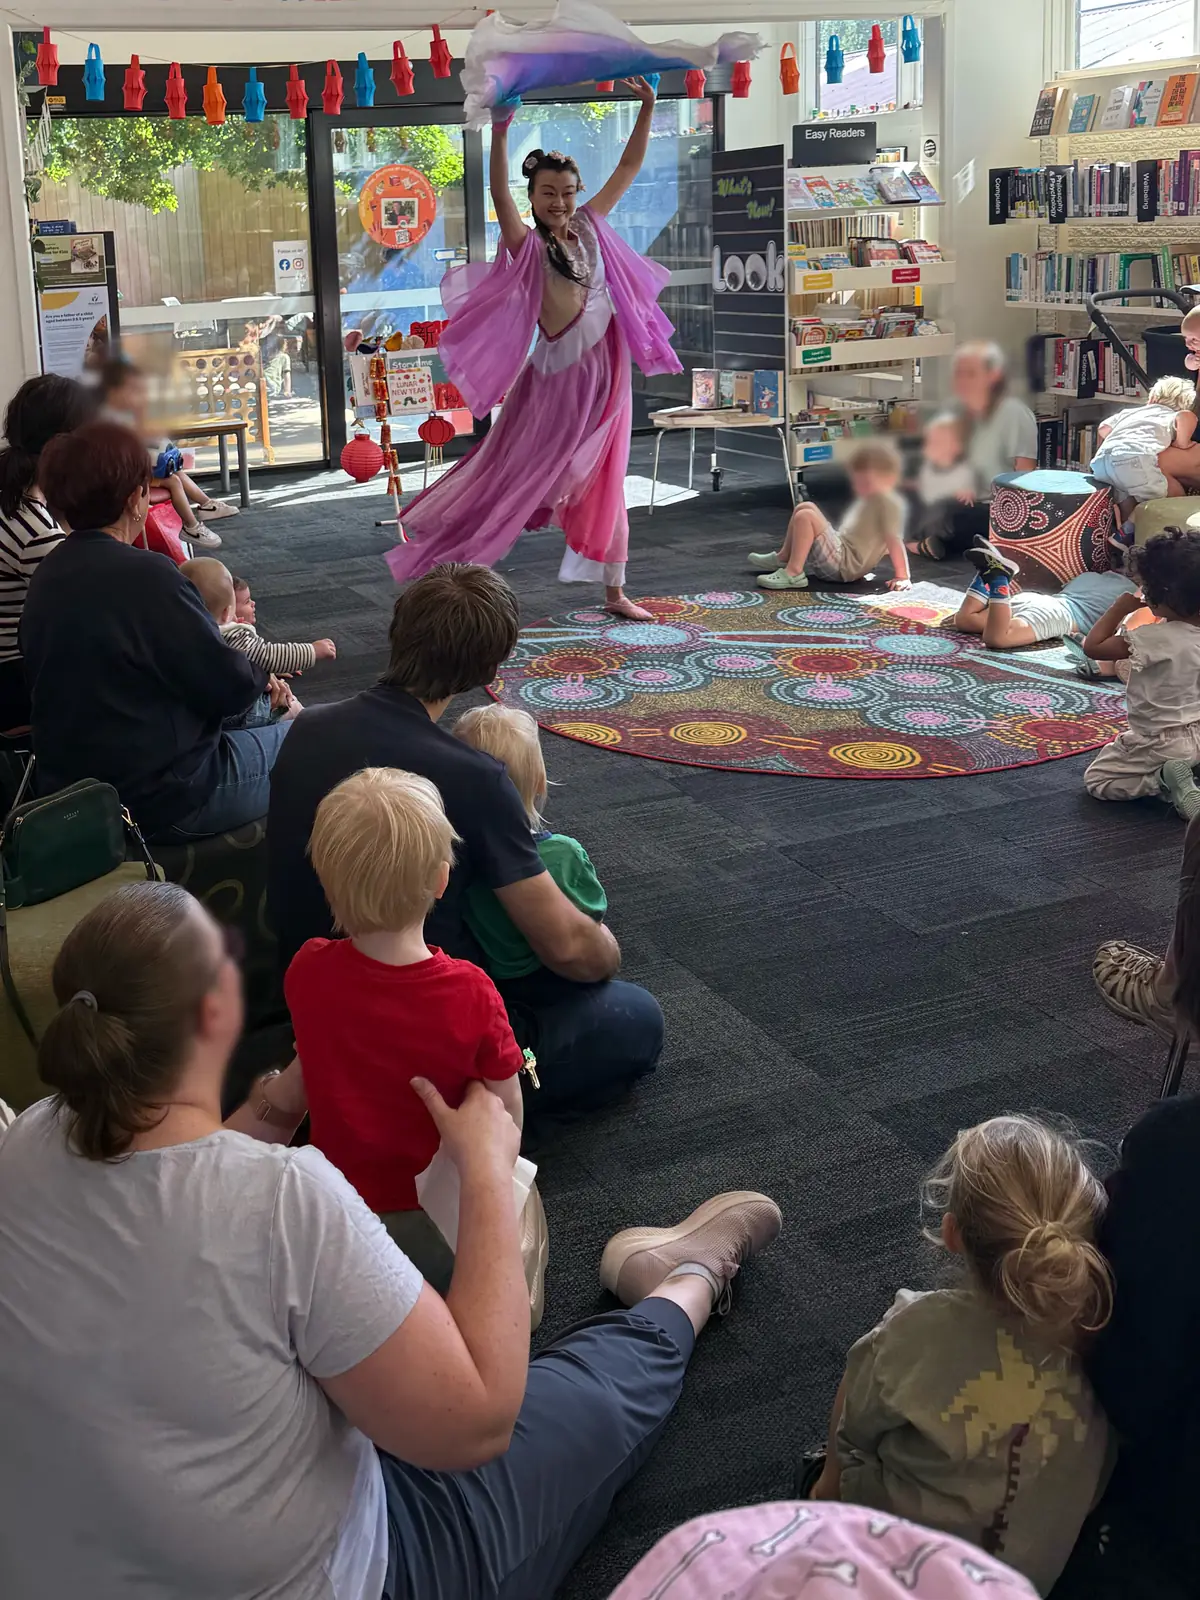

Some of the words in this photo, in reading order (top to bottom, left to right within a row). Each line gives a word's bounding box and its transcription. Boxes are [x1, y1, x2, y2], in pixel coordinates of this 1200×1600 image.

[805, 129, 828, 141] Easy
[829, 127, 866, 139] Readers
[994, 177, 1002, 215] Computers
[1056, 174, 1064, 213] Philosophy
[1142, 172, 1150, 210] Wellbeing
